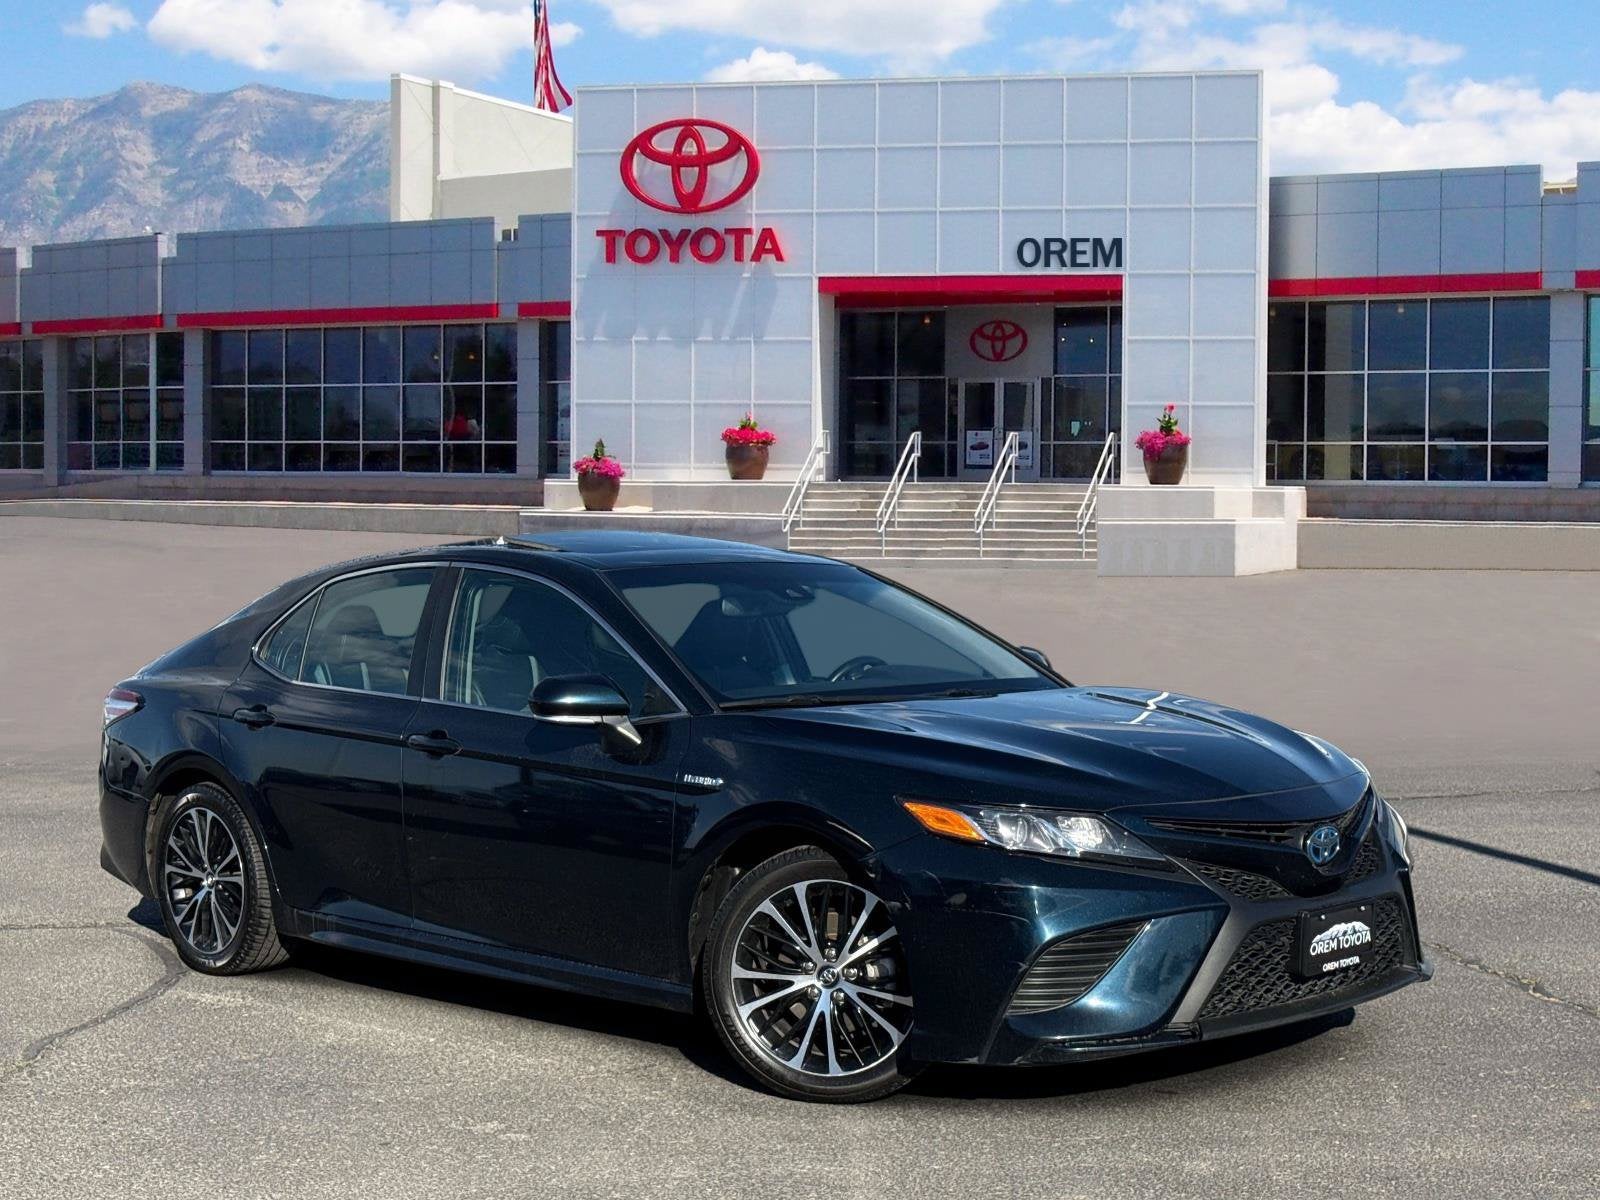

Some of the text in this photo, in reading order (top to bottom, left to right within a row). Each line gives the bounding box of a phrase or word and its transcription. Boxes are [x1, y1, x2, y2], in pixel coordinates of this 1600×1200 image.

[596, 227, 784, 264] TOYOTA
[1017, 237, 1123, 268] OREM
[1310, 930, 1372, 956] OREM TOYOTA
[1323, 956, 1360, 972] OREM TOYOTA
